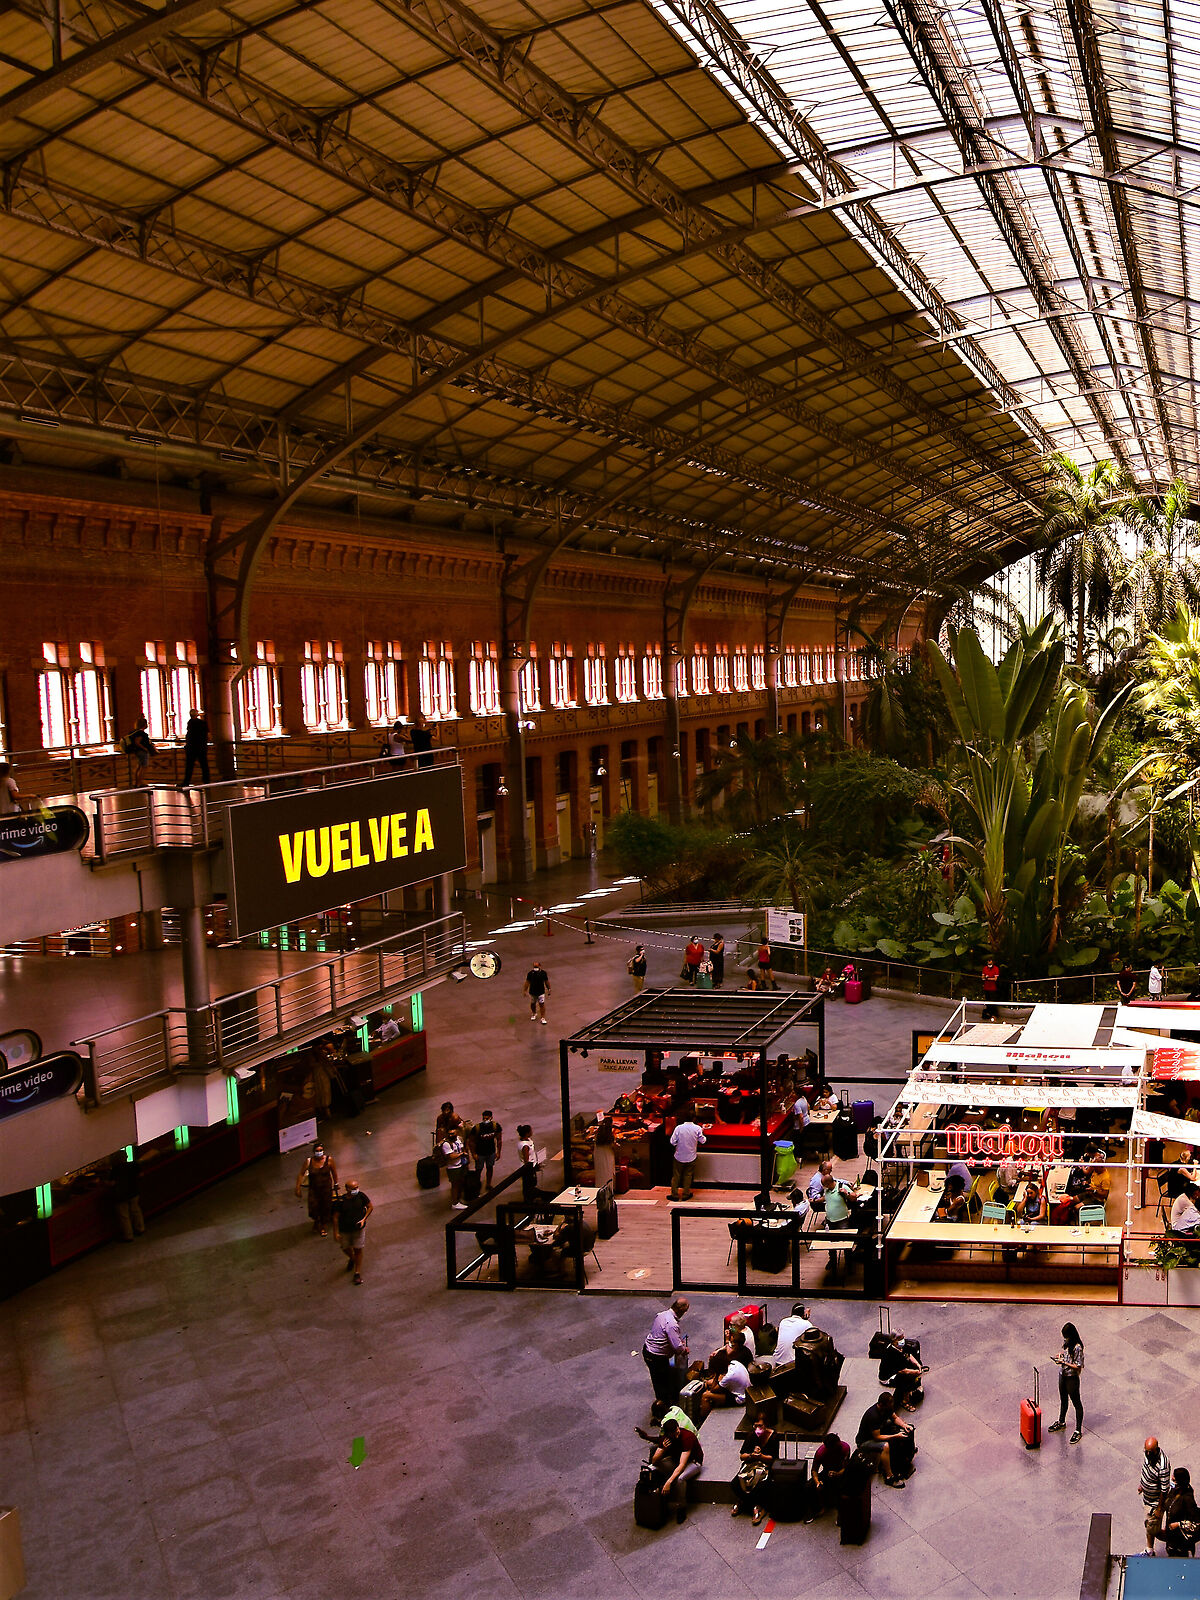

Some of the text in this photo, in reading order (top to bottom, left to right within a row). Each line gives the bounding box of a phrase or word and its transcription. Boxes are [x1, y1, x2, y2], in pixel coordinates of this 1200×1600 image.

[0, 822, 58, 840] rime video
[279, 808, 434, 883] VUELVE A
[24, 1071, 53, 1088] video
[945, 1123, 1064, 1157] Mahou
